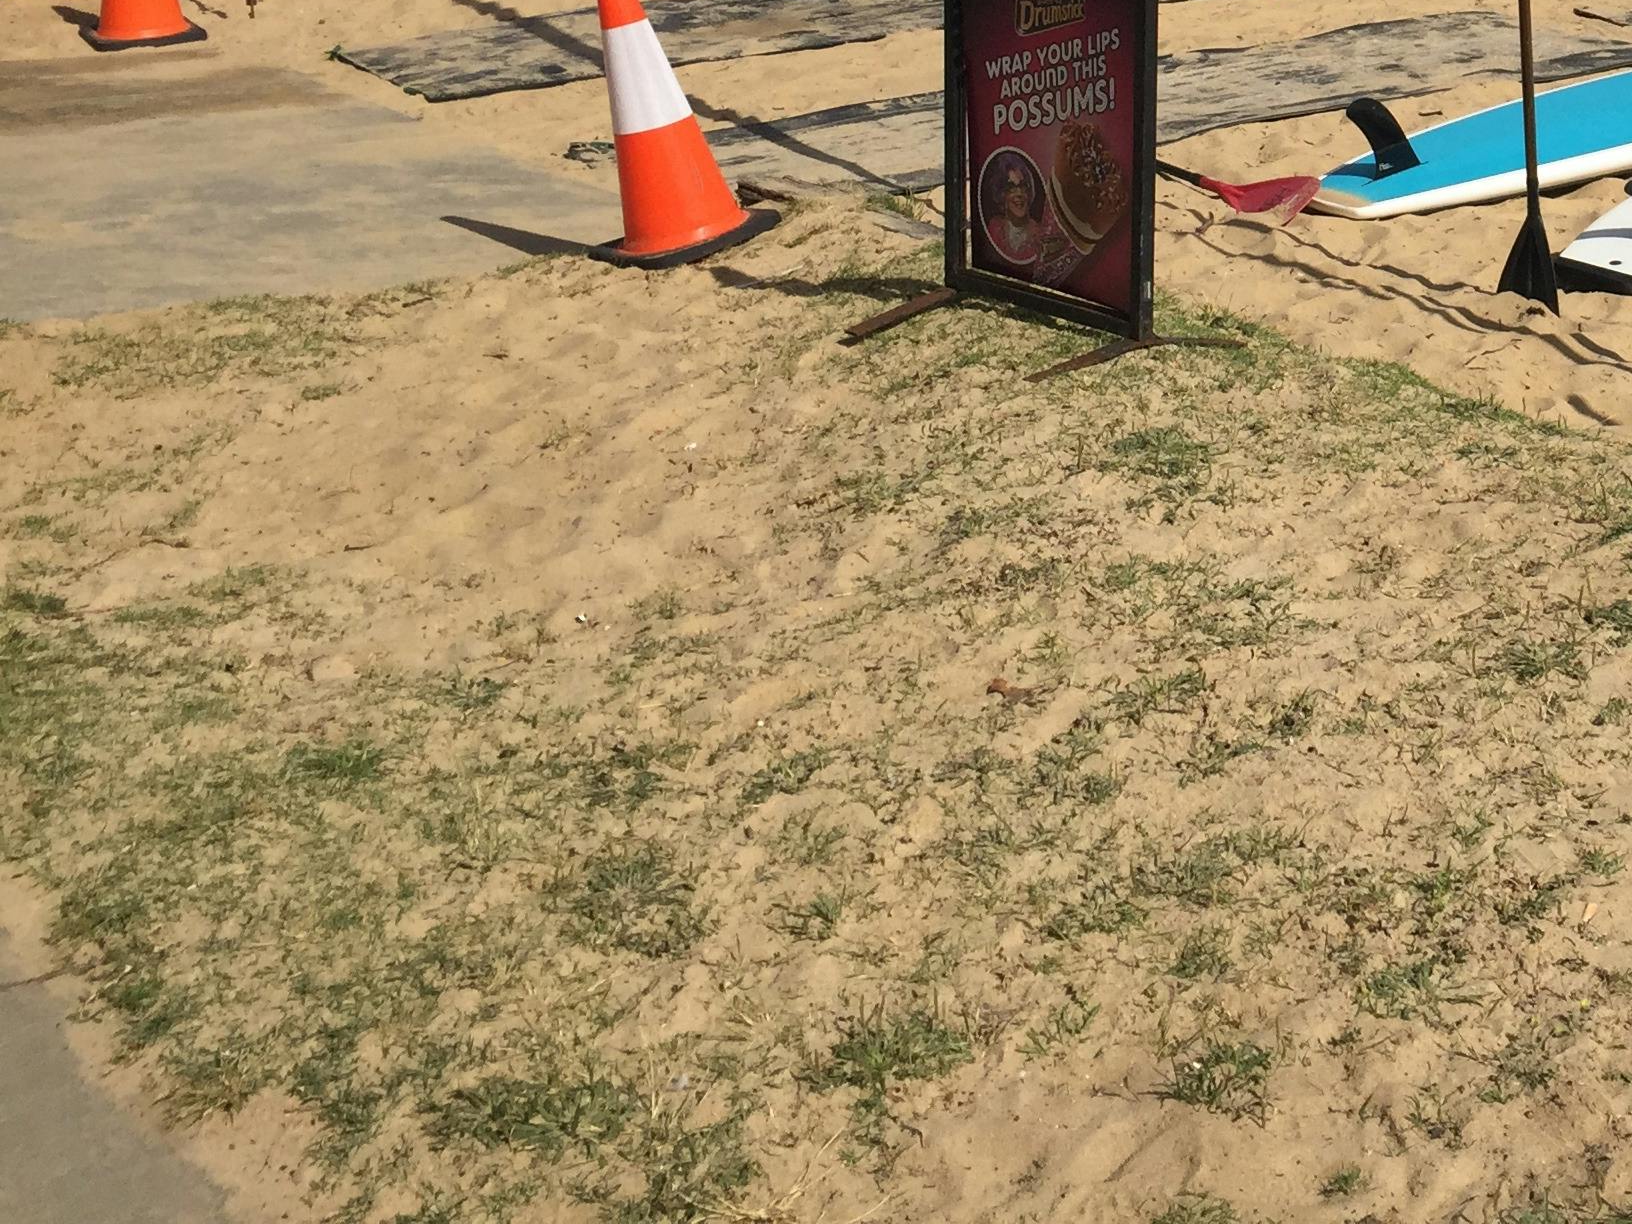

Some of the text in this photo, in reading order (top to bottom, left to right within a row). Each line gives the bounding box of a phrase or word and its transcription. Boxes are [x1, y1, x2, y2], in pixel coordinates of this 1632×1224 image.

[1019, 0, 1084, 31] Drumstick
[985, 28, 1120, 79] WRAP YOUR LIPS
[1000, 55, 1107, 99] AROUND THIS
[994, 77, 1116, 135] POSSUMS!
